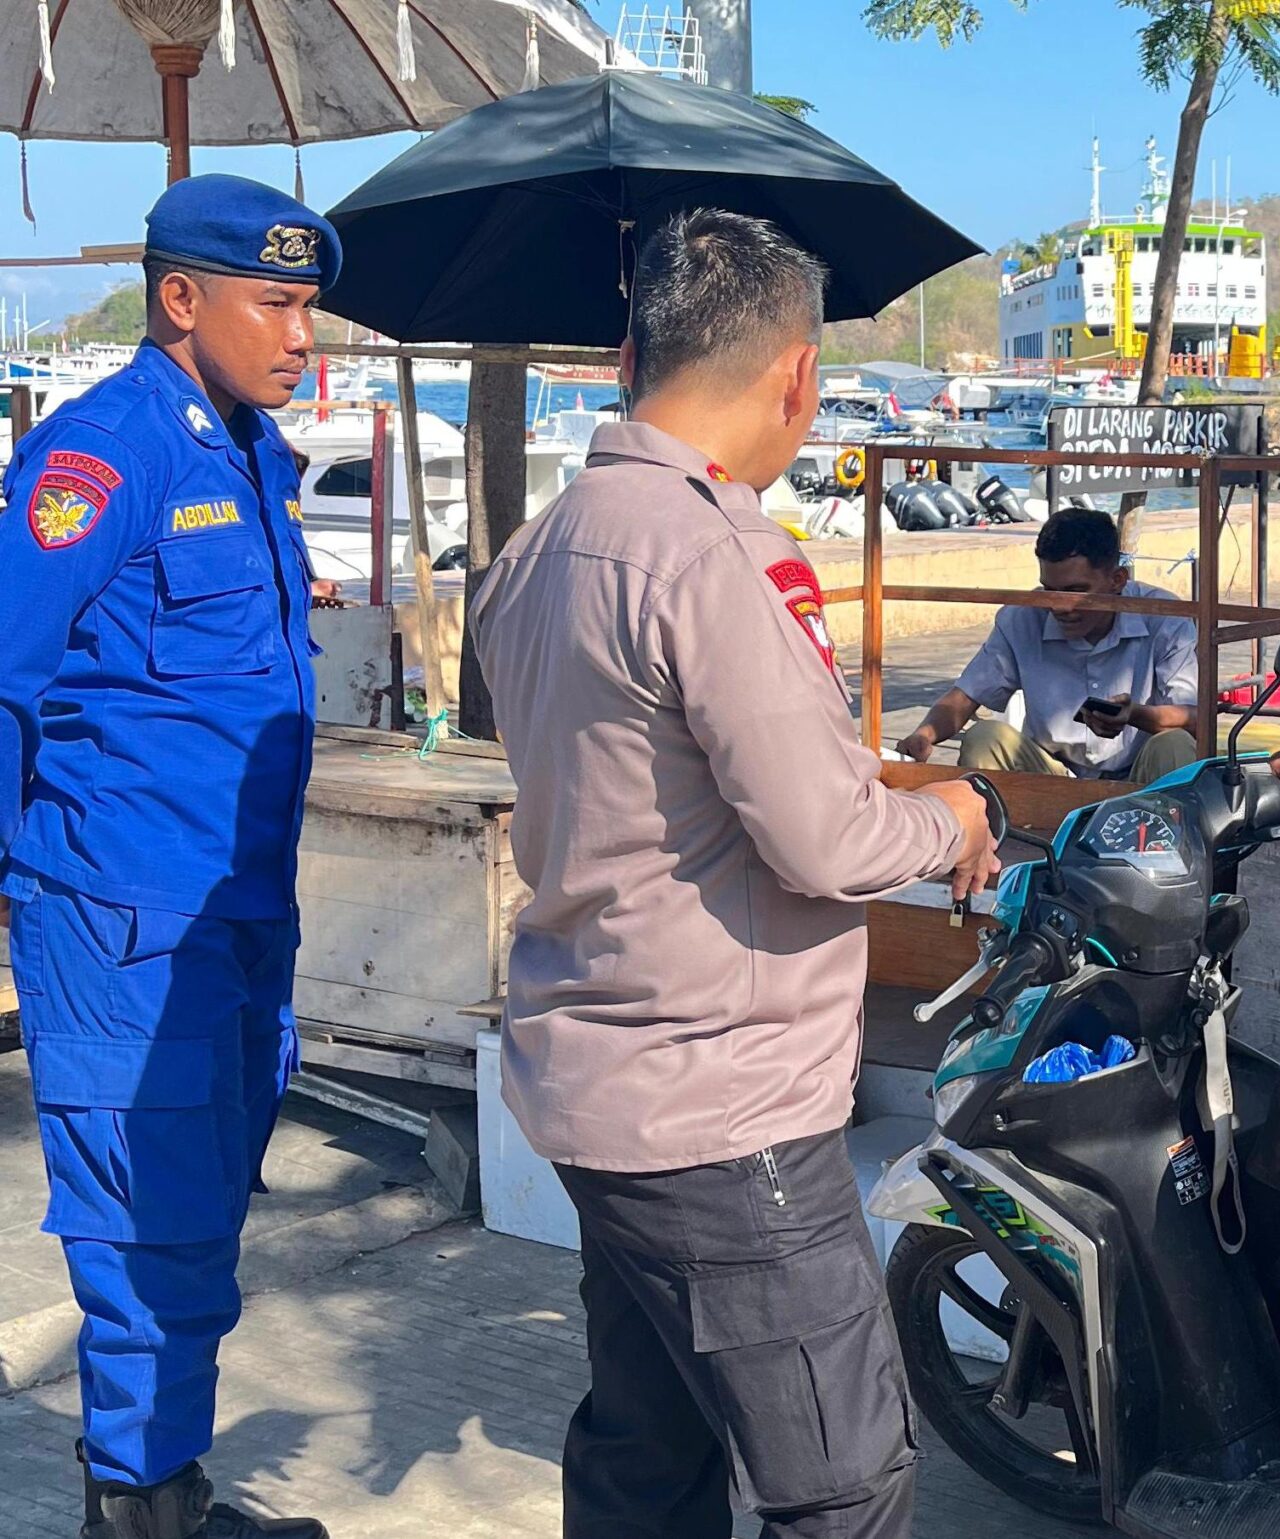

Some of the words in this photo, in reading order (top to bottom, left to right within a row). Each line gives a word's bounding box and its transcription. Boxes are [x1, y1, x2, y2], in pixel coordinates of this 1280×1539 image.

[1063, 407, 1083, 438] DI
[1088, 408, 1154, 438] LARANG
[1162, 409, 1229, 448] PARKIR
[1059, 438, 1131, 484] SPEDA
[1141, 440, 1217, 481] MOTO
